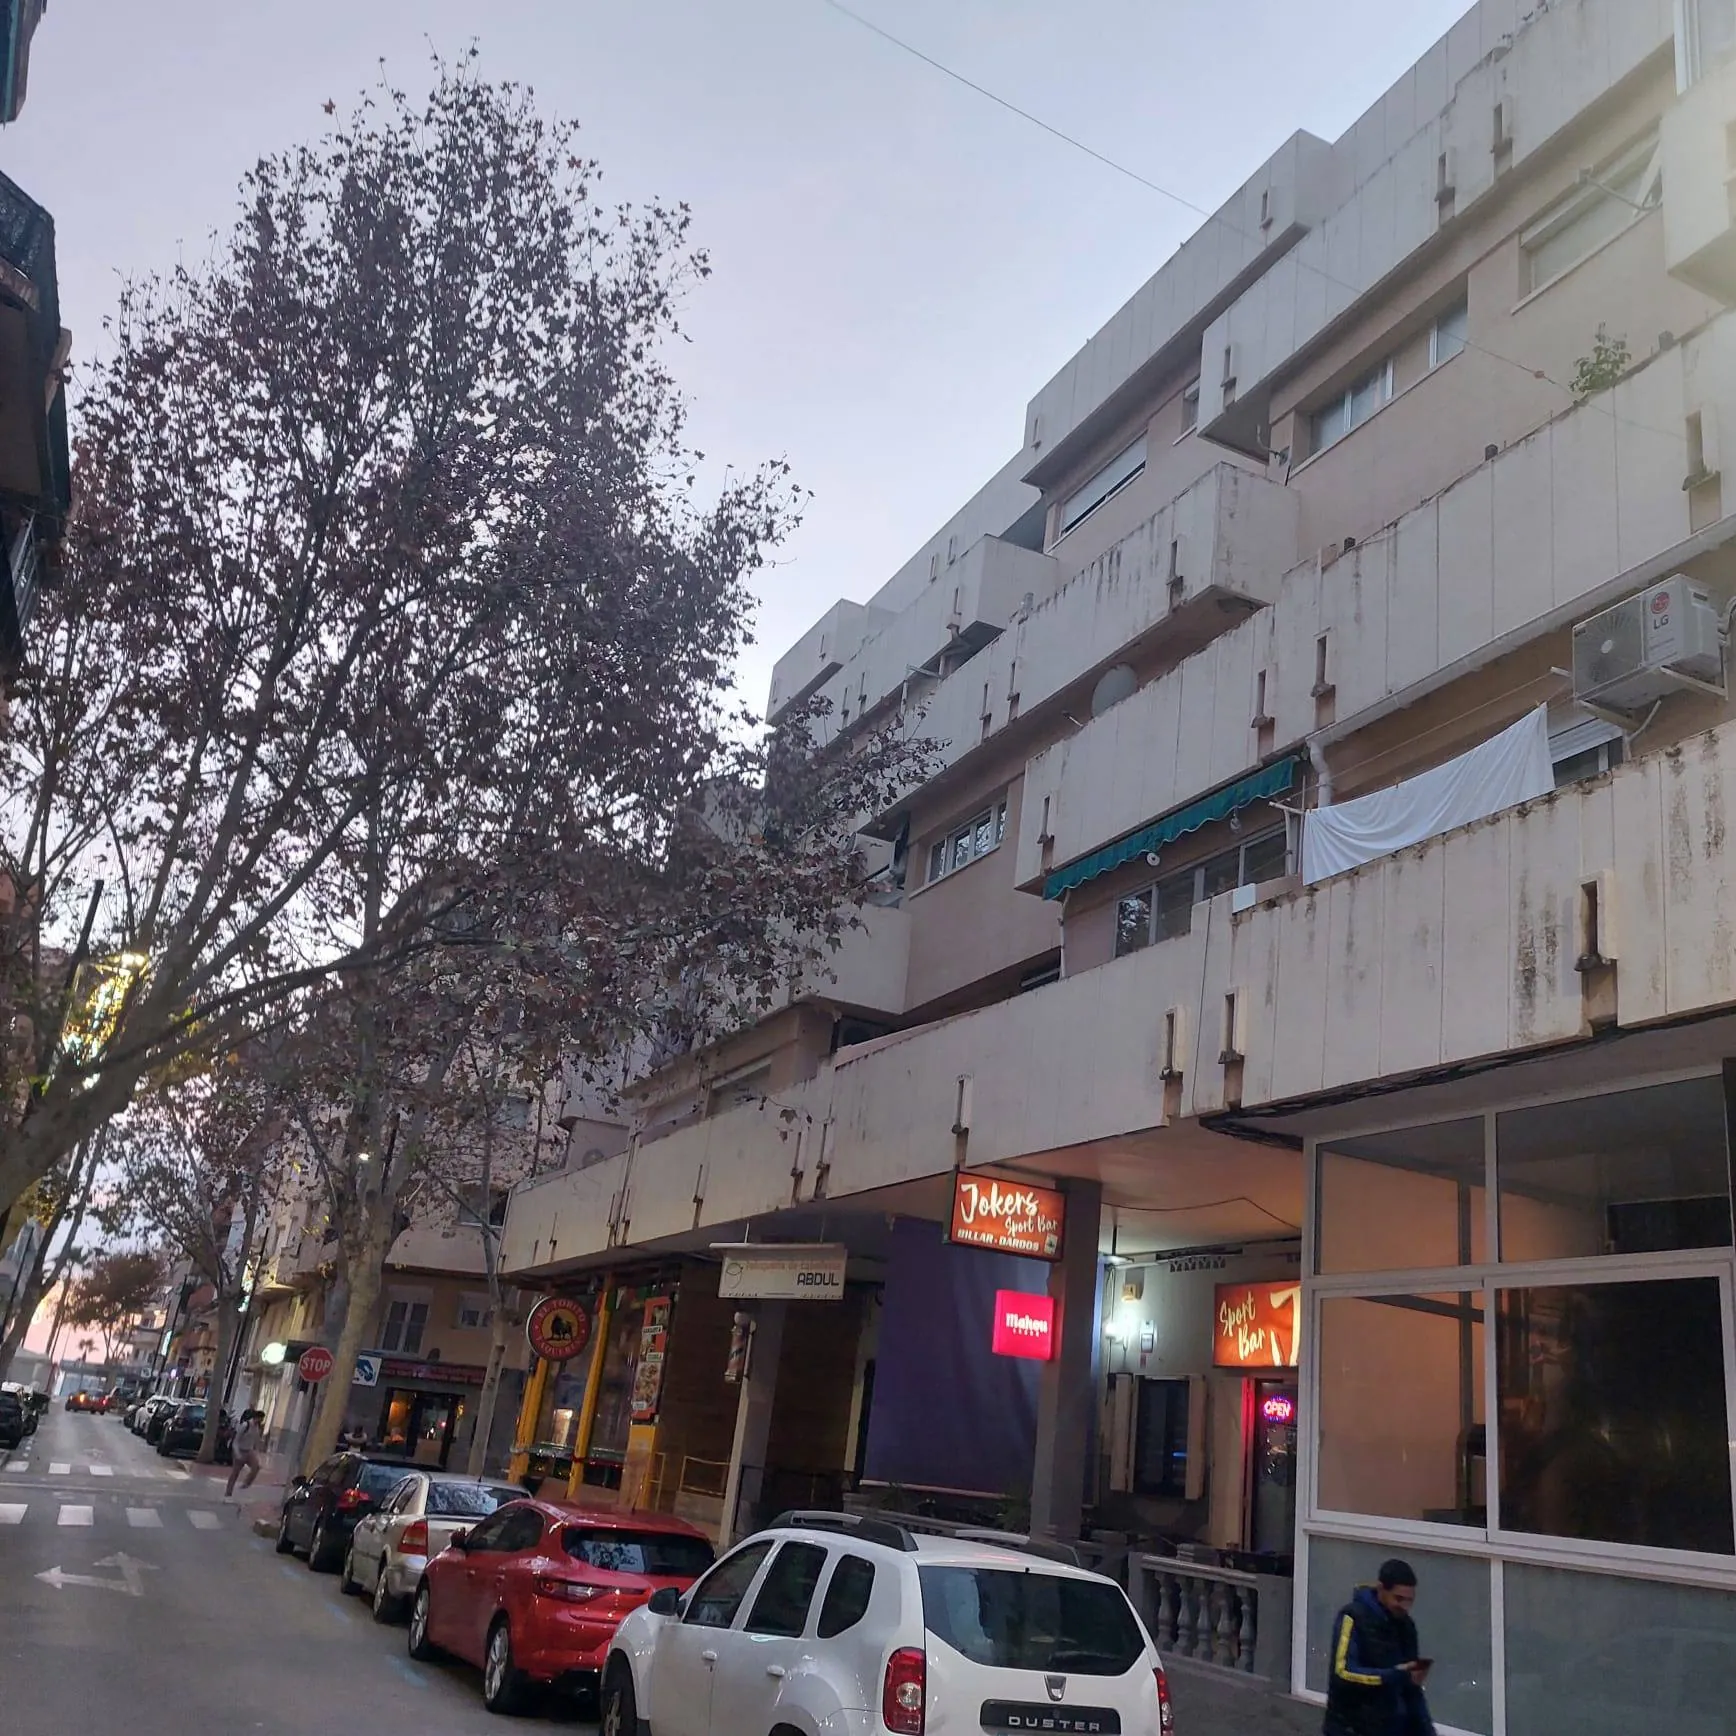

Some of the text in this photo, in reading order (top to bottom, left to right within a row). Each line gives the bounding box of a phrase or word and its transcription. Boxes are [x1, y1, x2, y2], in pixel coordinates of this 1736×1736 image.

[1653, 614, 1669, 630] LG
[961, 1182, 1039, 1224] Jokers
[1005, 1214, 1058, 1237] Sport Bar
[957, 1229, 1039, 1252] BILLAR DARDOS
[797, 1272, 840, 1286] ABDUL
[1006, 1312, 1048, 1334] Mahou
[1219, 1290, 1256, 1338] Sport
[1238, 1325, 1266, 1361] Bar
[301, 1357, 331, 1373] STOP
[1264, 1400, 1292, 1417] OPEN
[1008, 1716, 1100, 1731] DUSTER
